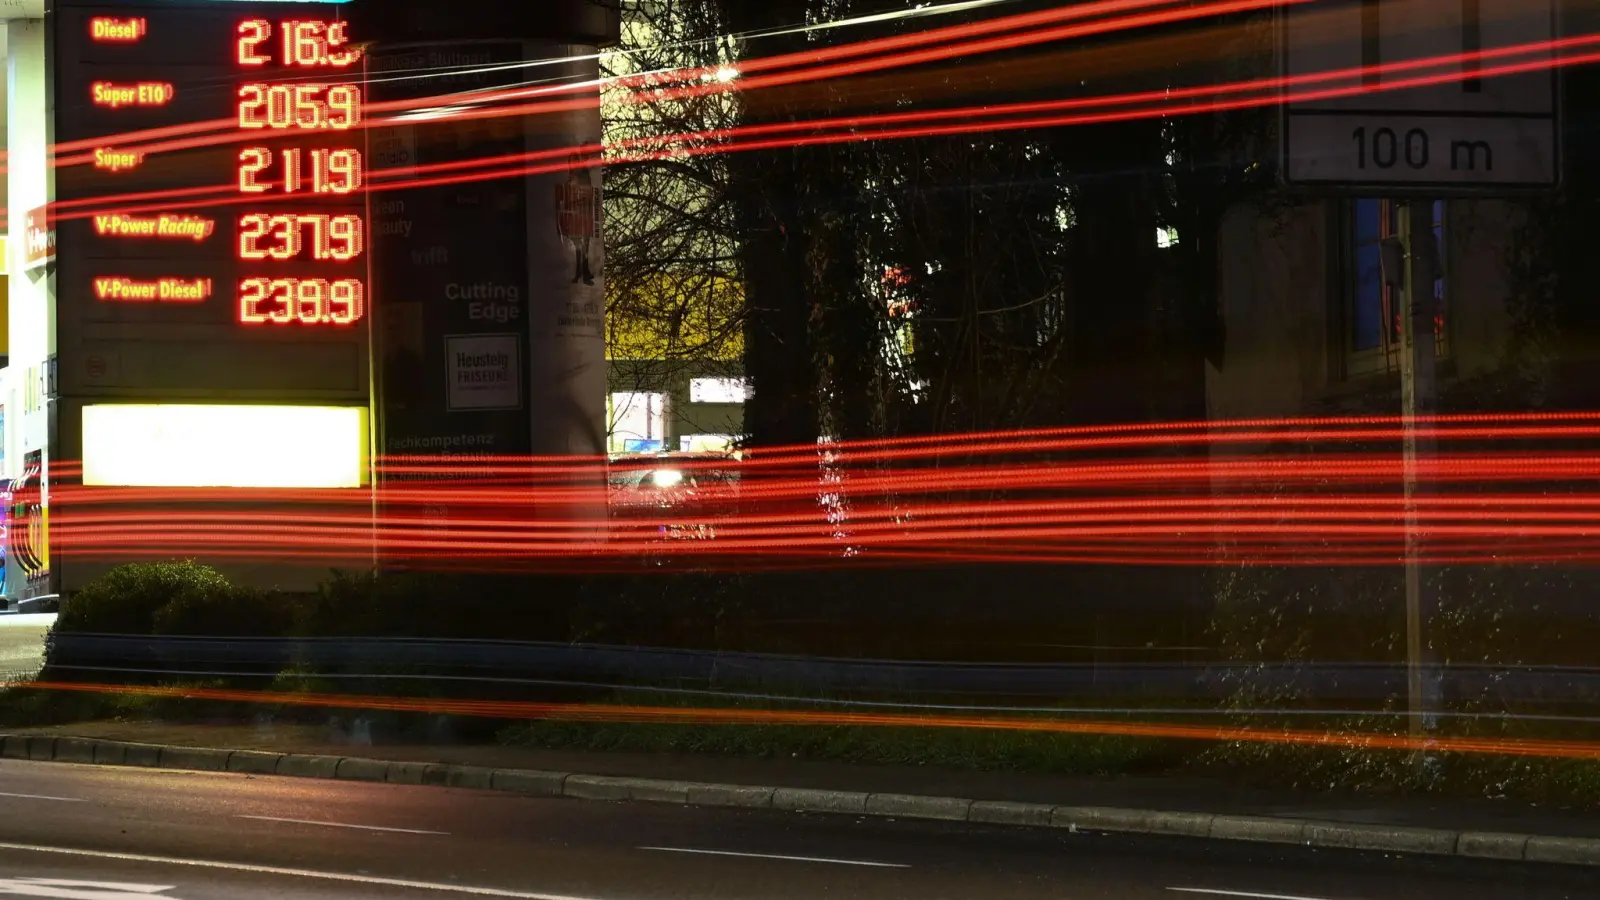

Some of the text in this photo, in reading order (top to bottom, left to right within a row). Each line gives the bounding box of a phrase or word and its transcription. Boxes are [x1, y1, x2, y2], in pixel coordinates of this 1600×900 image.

[92, 18, 142, 39] Diesel
[92, 83, 361, 129] Super E10 205.9
[1352, 127, 1493, 171] 100 m
[93, 147, 362, 193] Super 211.9
[96, 214, 362, 260] V-Power Racing 237.9
[96, 277, 363, 324] V-Power Diesel 239.9
[445, 282, 519, 302] Cutting
[468, 302, 520, 322] Edge
[456, 352, 508, 369] Heusteig
[388, 433, 495, 449] Fachkompetenz
